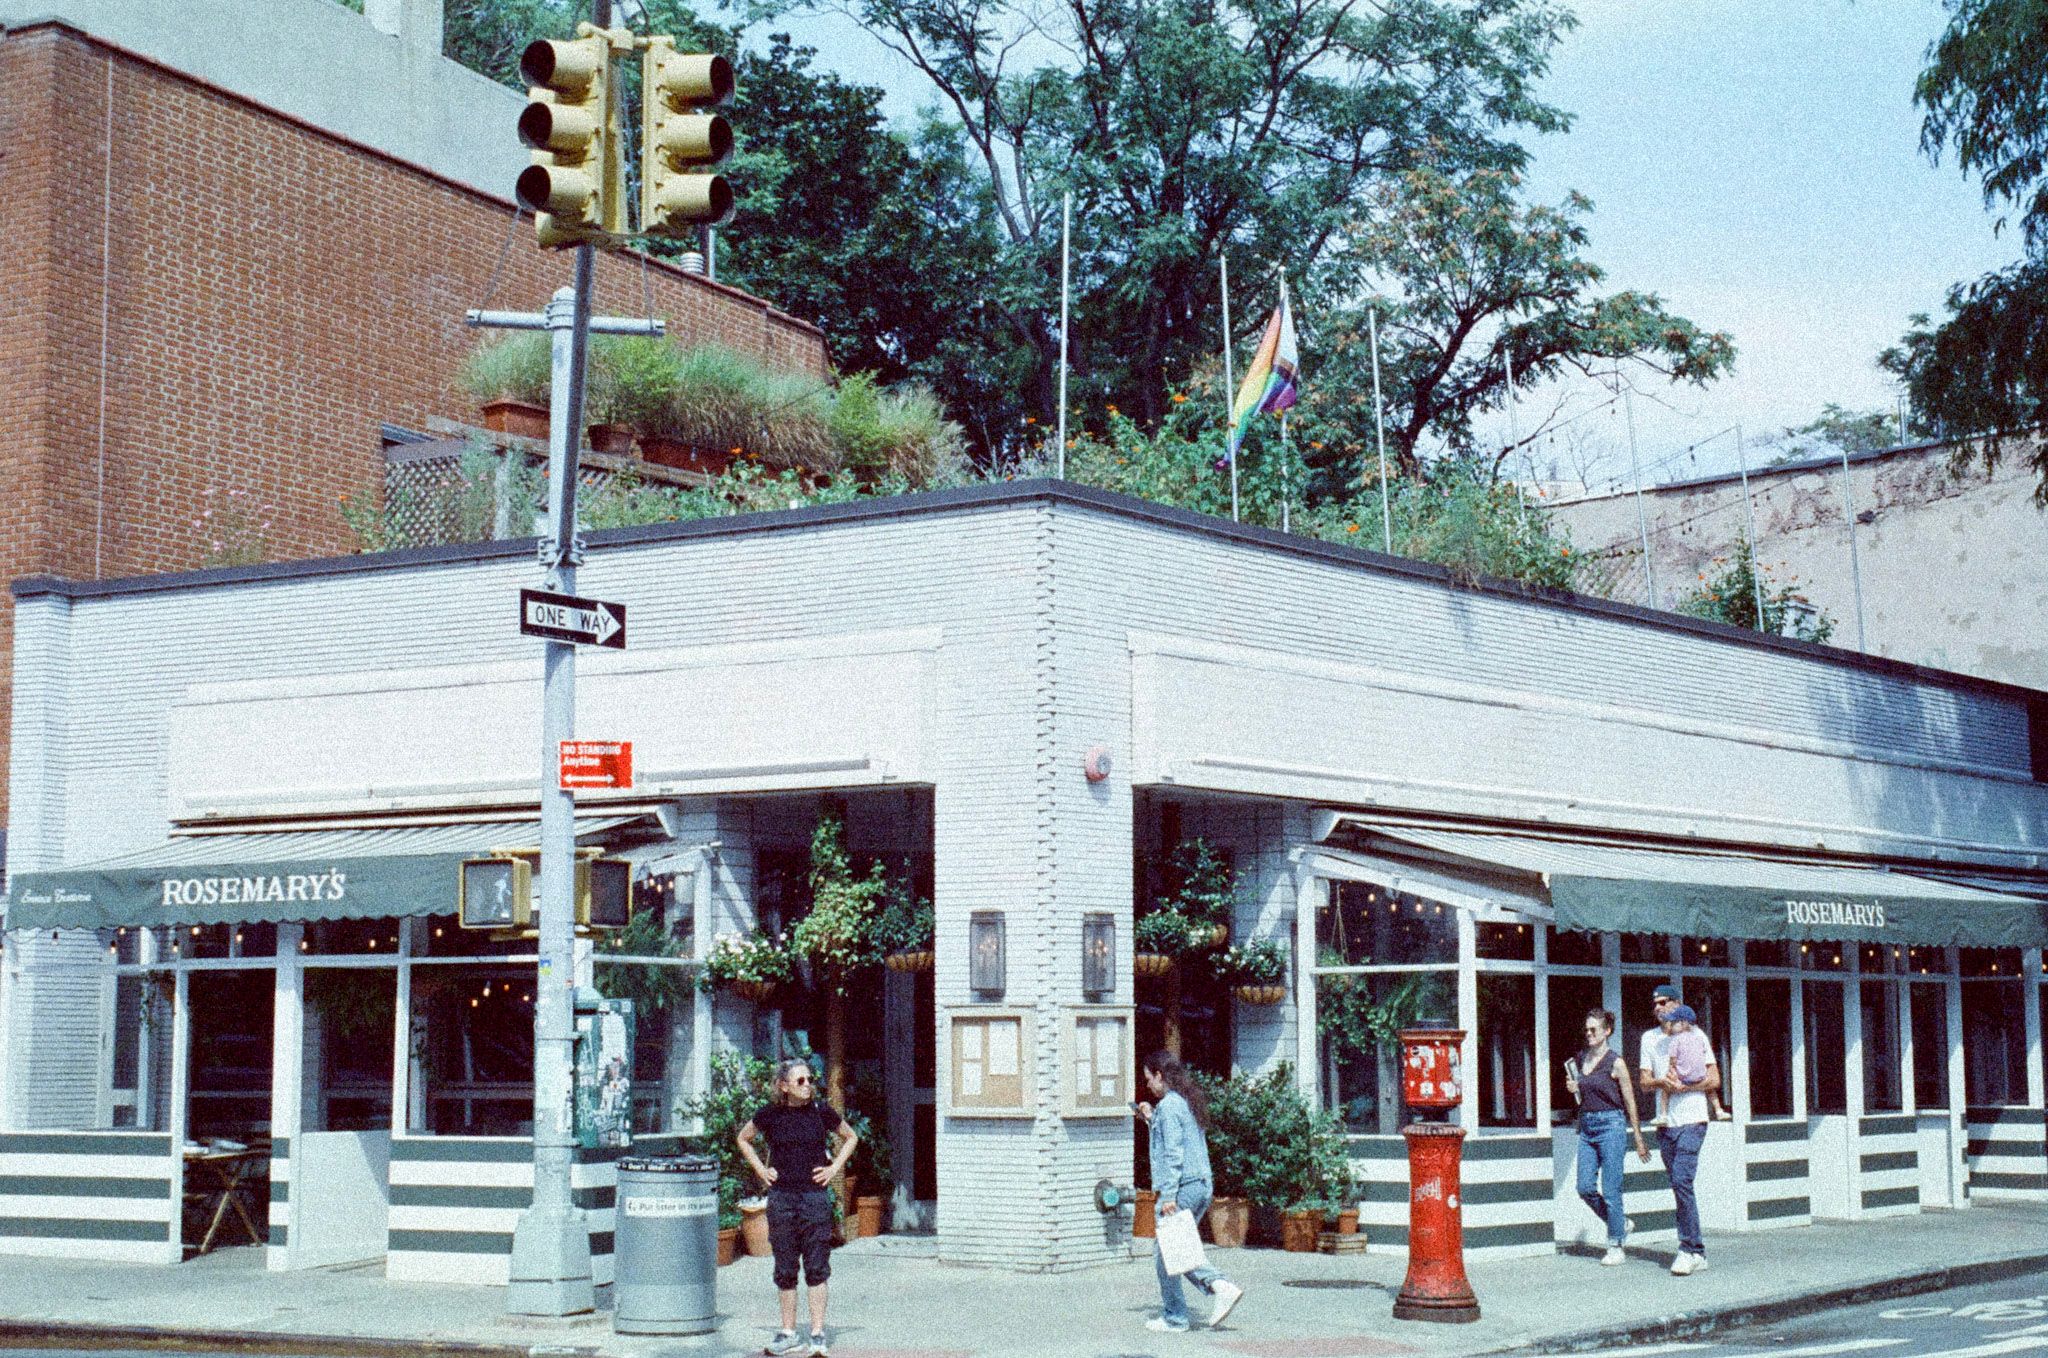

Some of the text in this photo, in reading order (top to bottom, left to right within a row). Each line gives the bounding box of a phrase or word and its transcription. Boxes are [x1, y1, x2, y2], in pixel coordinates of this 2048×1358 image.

[535, 604, 610, 633] ONE WAY
[161, 866, 347, 907] ROSEMARY'S
[1786, 899, 1885, 928] ROSEMARY'S
